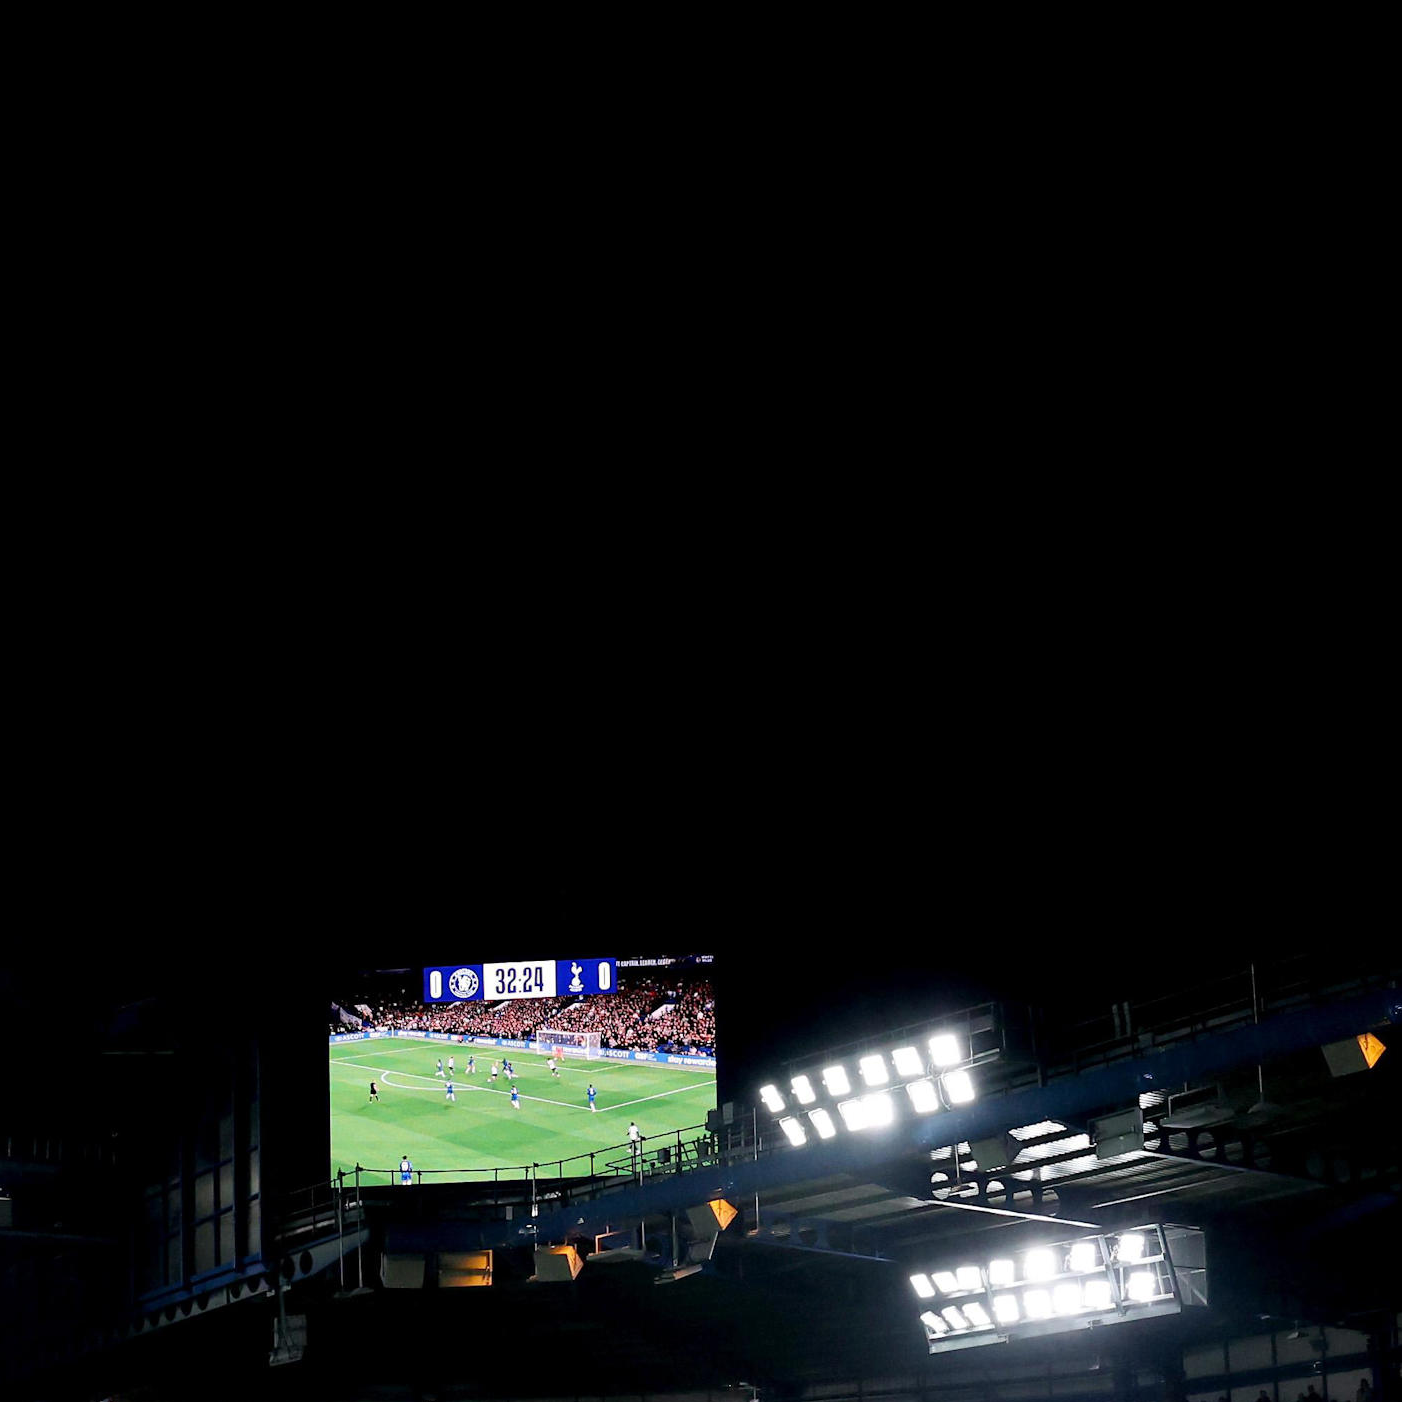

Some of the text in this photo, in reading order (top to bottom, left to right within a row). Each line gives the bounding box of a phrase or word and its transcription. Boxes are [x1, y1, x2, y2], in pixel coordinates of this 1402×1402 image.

[430, 970, 442, 997] 0
[495, 967, 544, 994] 32:24
[598, 962, 611, 990] 0
